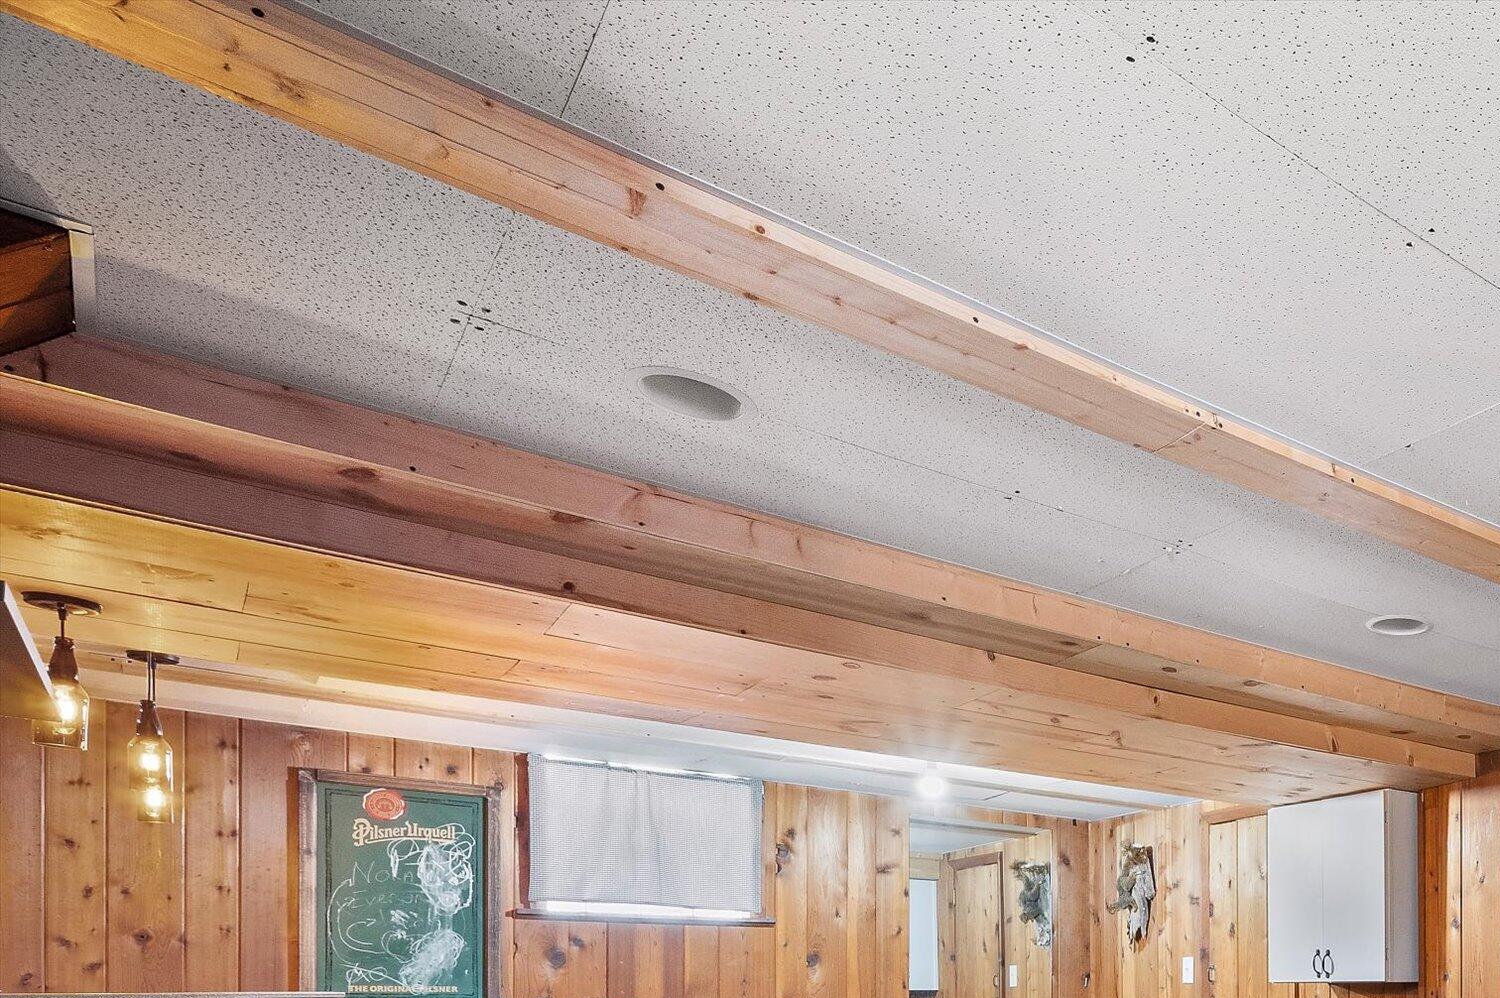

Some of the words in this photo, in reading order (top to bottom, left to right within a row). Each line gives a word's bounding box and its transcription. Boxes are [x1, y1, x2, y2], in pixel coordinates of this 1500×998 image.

[352, 818, 407, 847] Pilsner
[404, 820, 456, 842] Urquell
[349, 984, 368, 993] THE
